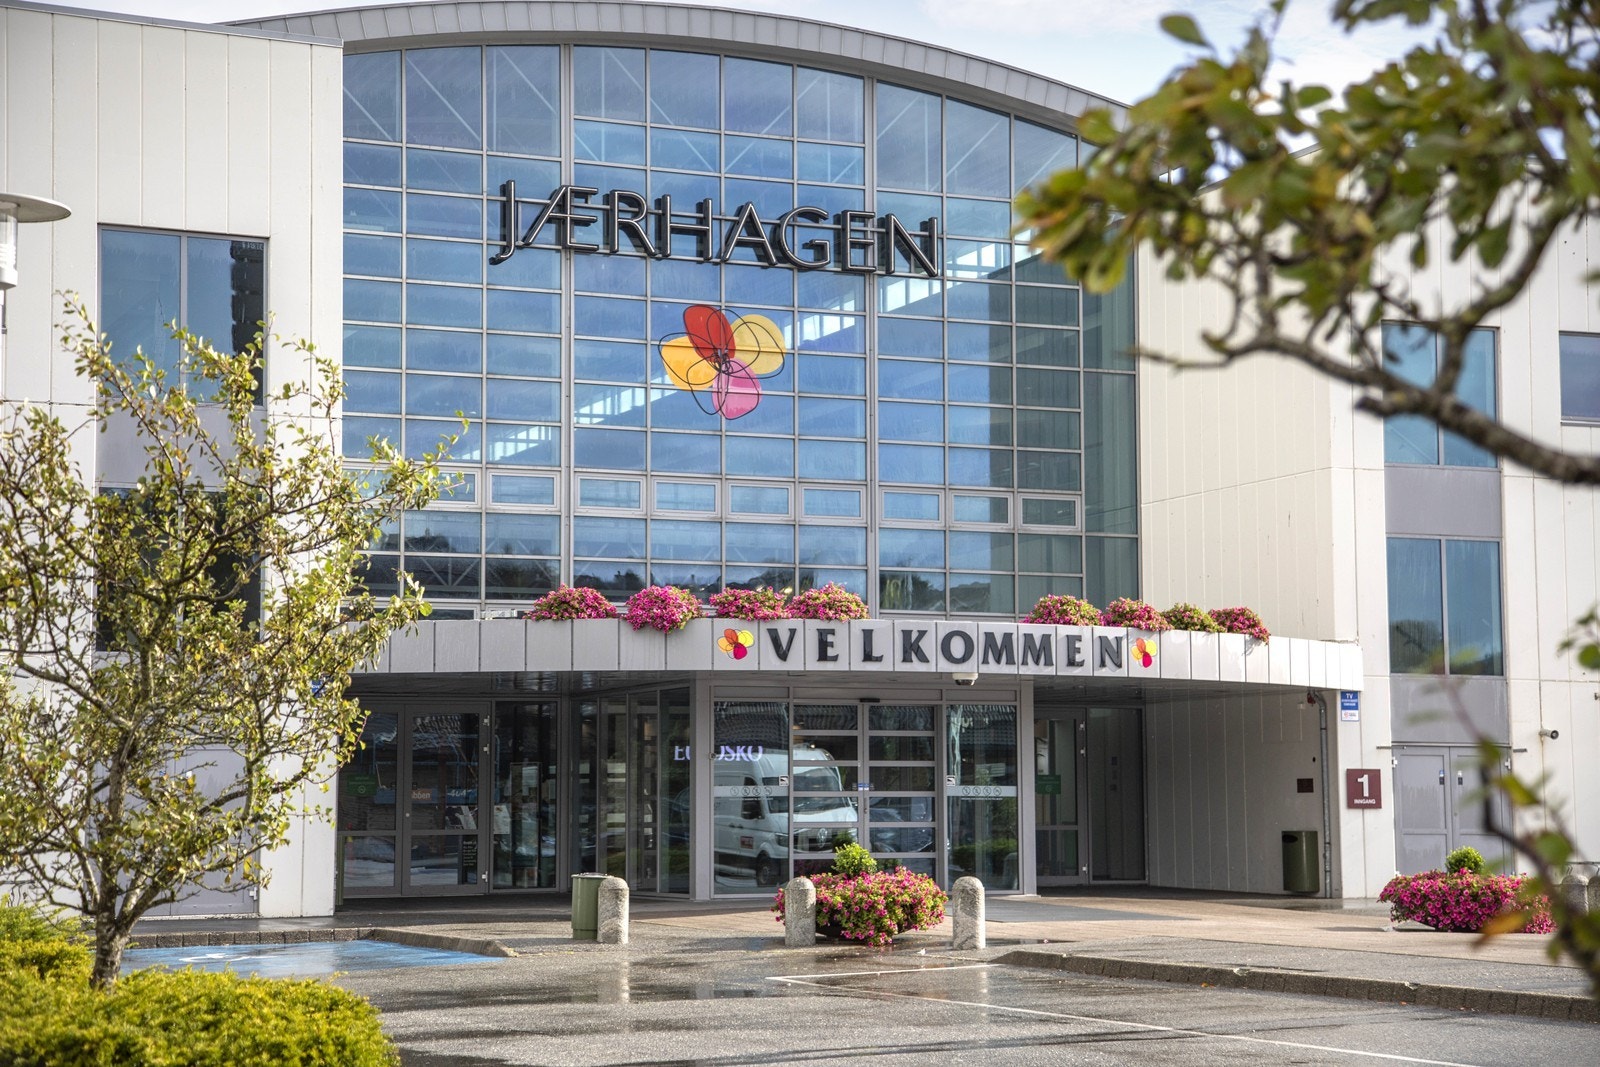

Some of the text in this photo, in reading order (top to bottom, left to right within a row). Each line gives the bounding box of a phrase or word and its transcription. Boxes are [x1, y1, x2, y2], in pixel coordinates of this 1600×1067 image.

[489, 180, 939, 277] JÆRHAGEN
[766, 627, 1123, 669] VELKOMMEN
[1357, 774, 1369, 797] 1
